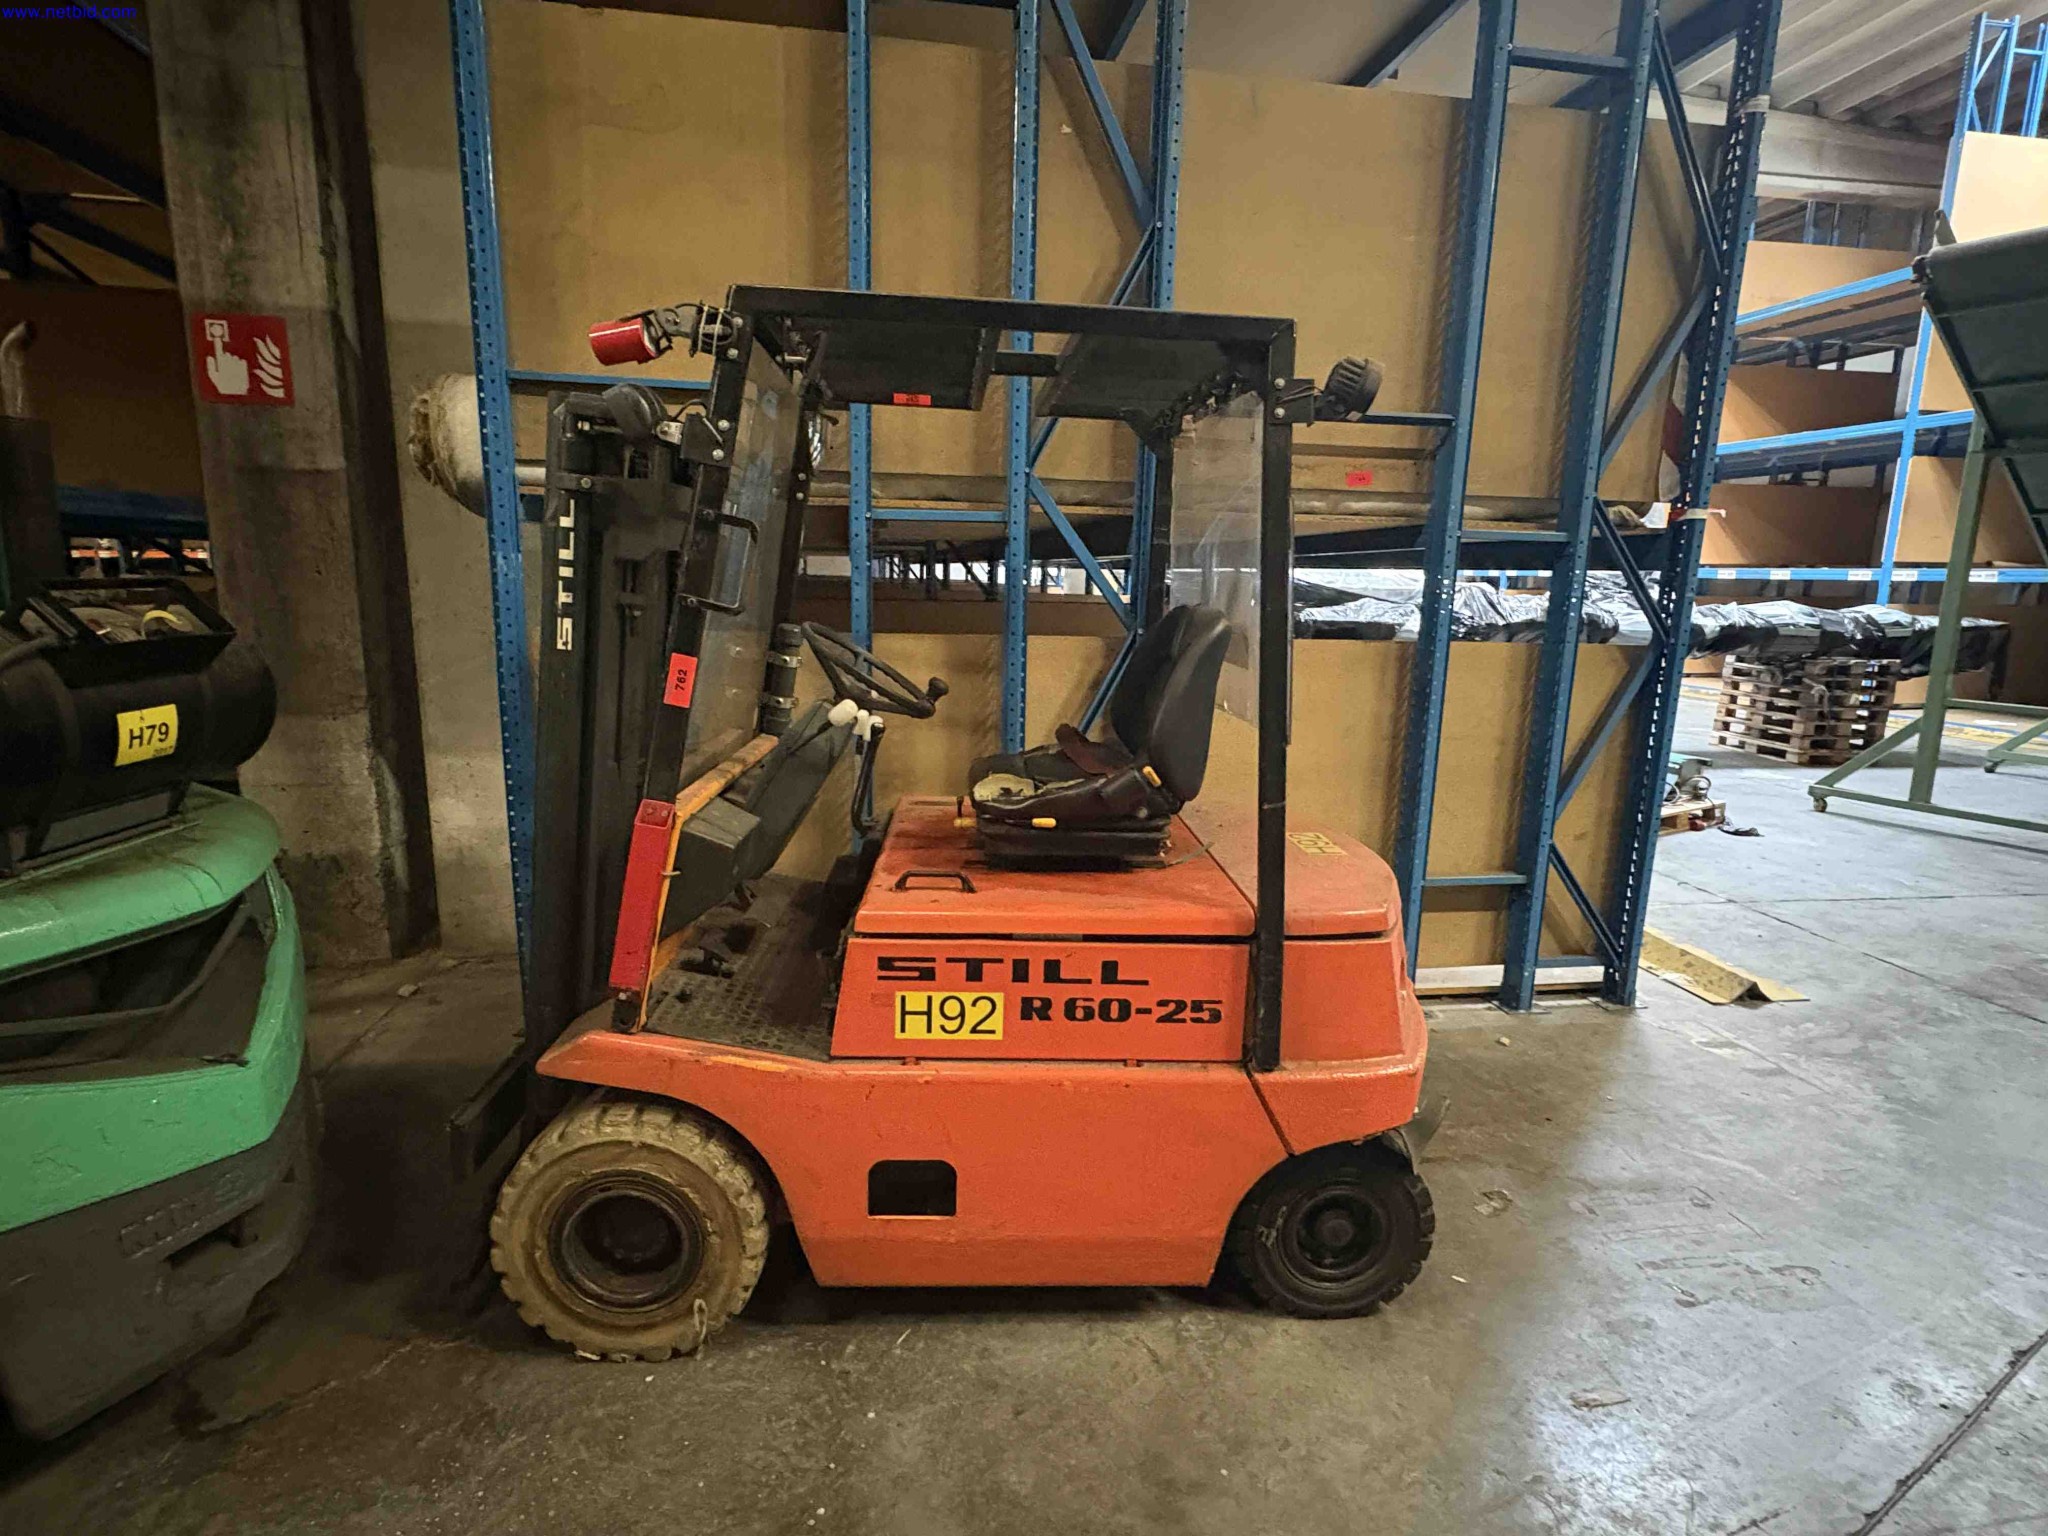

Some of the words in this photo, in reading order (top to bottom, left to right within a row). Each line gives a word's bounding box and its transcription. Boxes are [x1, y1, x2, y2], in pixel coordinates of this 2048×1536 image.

[557, 499, 575, 651] STILL
[674, 669, 688, 691] 762
[128, 722, 169, 749] H79
[877, 957, 1149, 986] STILL
[899, 995, 997, 1035] H92
[1020, 997, 1053, 1021] R
[1064, 997, 1223, 1024] 60-25
